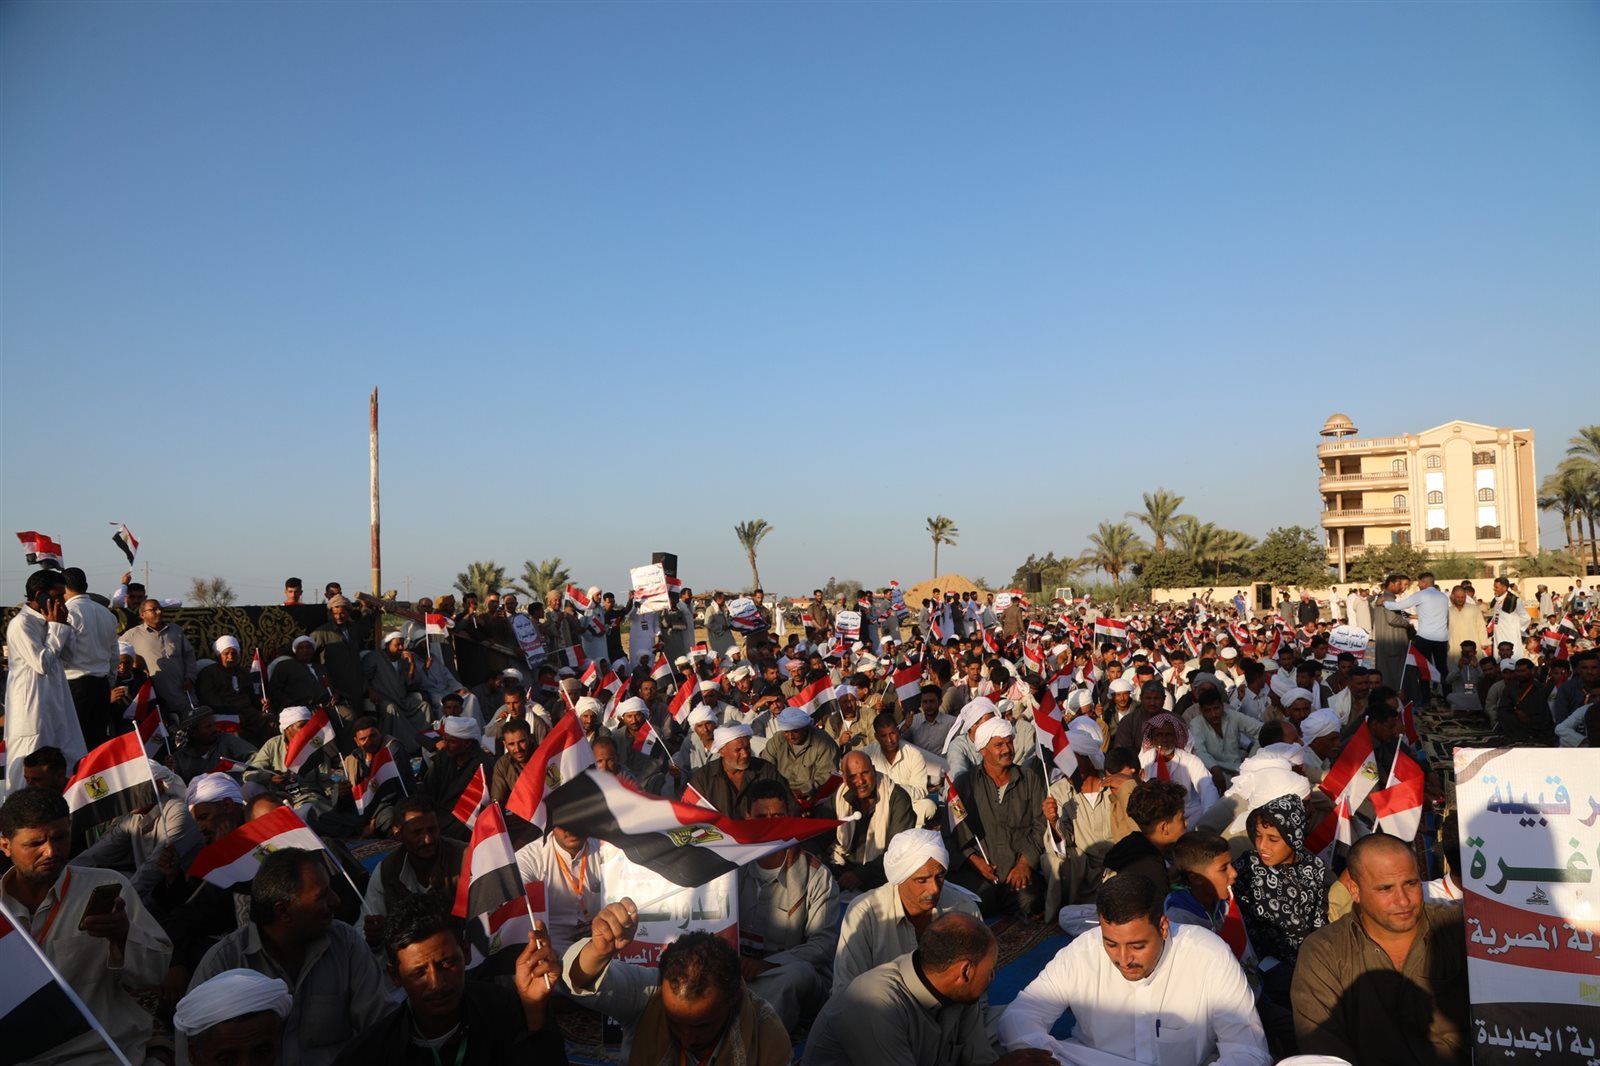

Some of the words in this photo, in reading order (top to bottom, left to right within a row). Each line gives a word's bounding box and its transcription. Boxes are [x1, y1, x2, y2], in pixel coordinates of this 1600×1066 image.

[1482, 775, 1571, 828] قبيلة
[1467, 917, 1559, 955] المصرية
[1474, 1018, 1563, 1058] الجديدة
